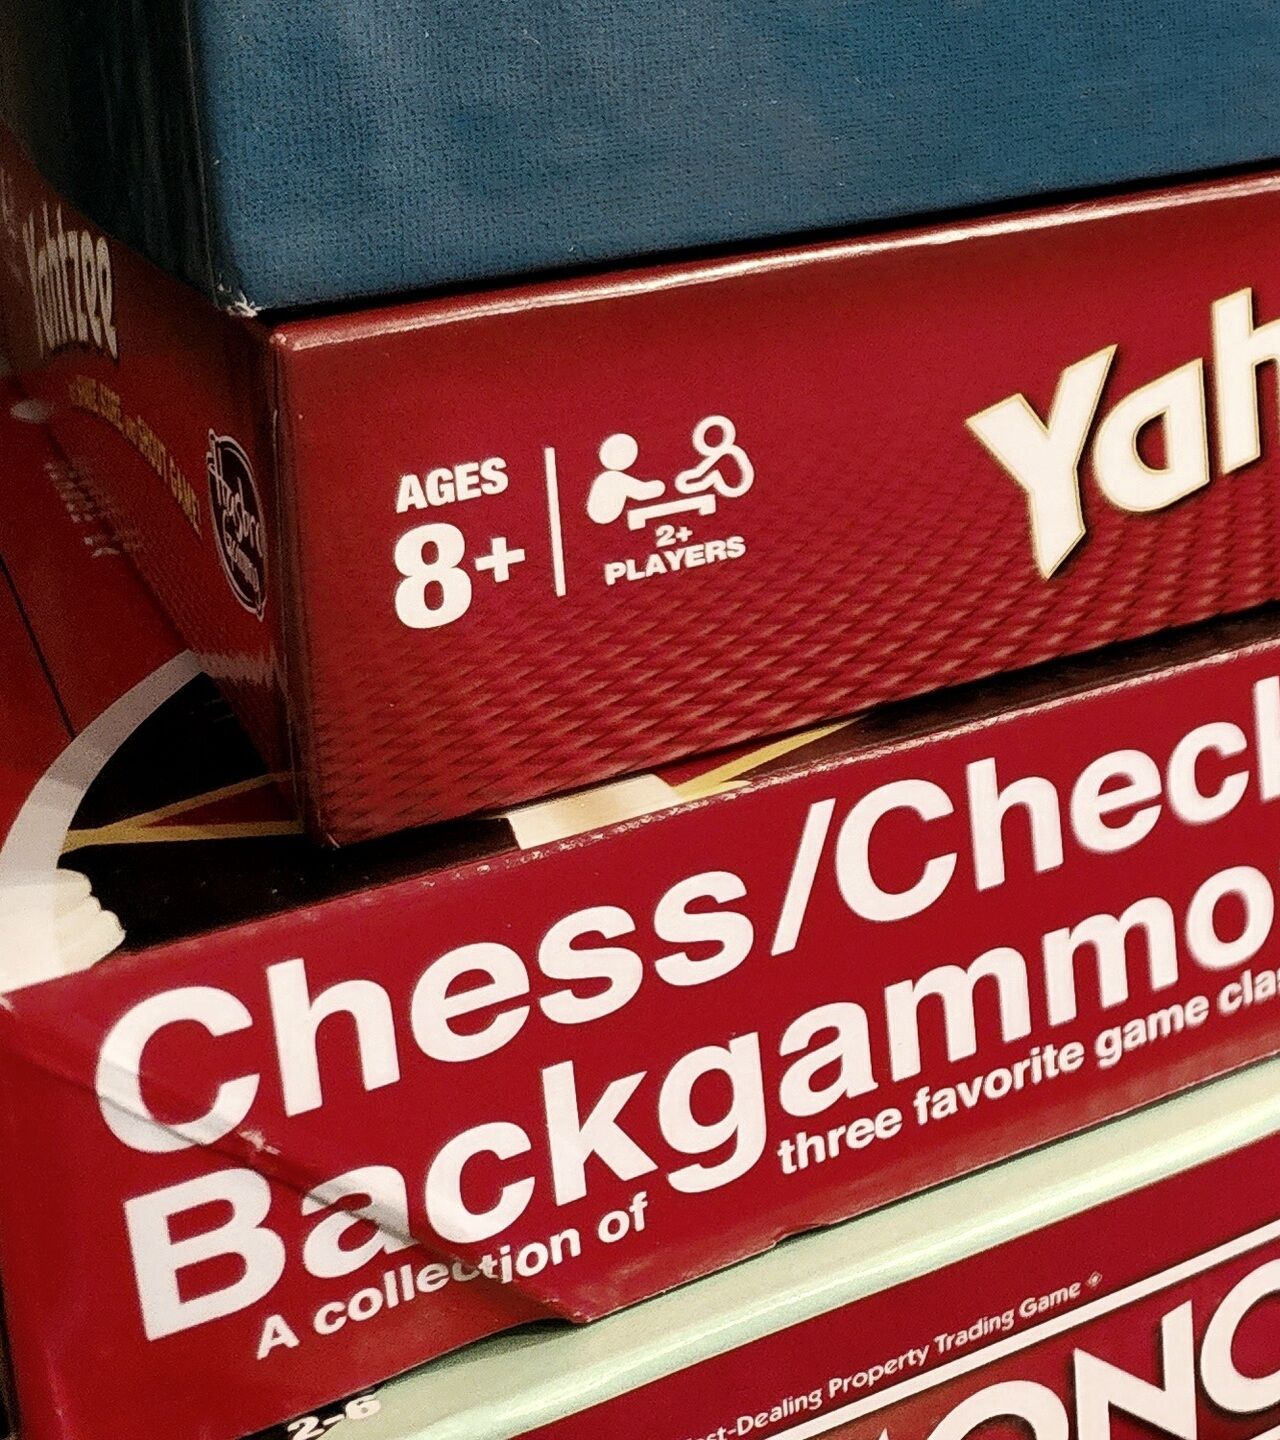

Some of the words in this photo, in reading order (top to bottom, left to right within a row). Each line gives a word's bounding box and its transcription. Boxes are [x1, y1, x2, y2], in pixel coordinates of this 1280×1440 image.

[22, 200, 118, 360] Yahtzee
[395, 456, 509, 514] AGES
[656, 525, 693, 547] 2+
[394, 522, 526, 630] 8+
[604, 535, 746, 585] PLAYERS
[254, 1313, 299, 1361] A
[313, 1227, 581, 1335] collection
[597, 1192, 649, 1253] of
[777, 1106, 903, 1175] three
[912, 1037, 1085, 1127] favorite
[1095, 994, 1210, 1070] game
[828, 1343, 930, 1399] Property
[934, 1306, 1015, 1355] Trading
[1018, 1280, 1082, 1319] Game
